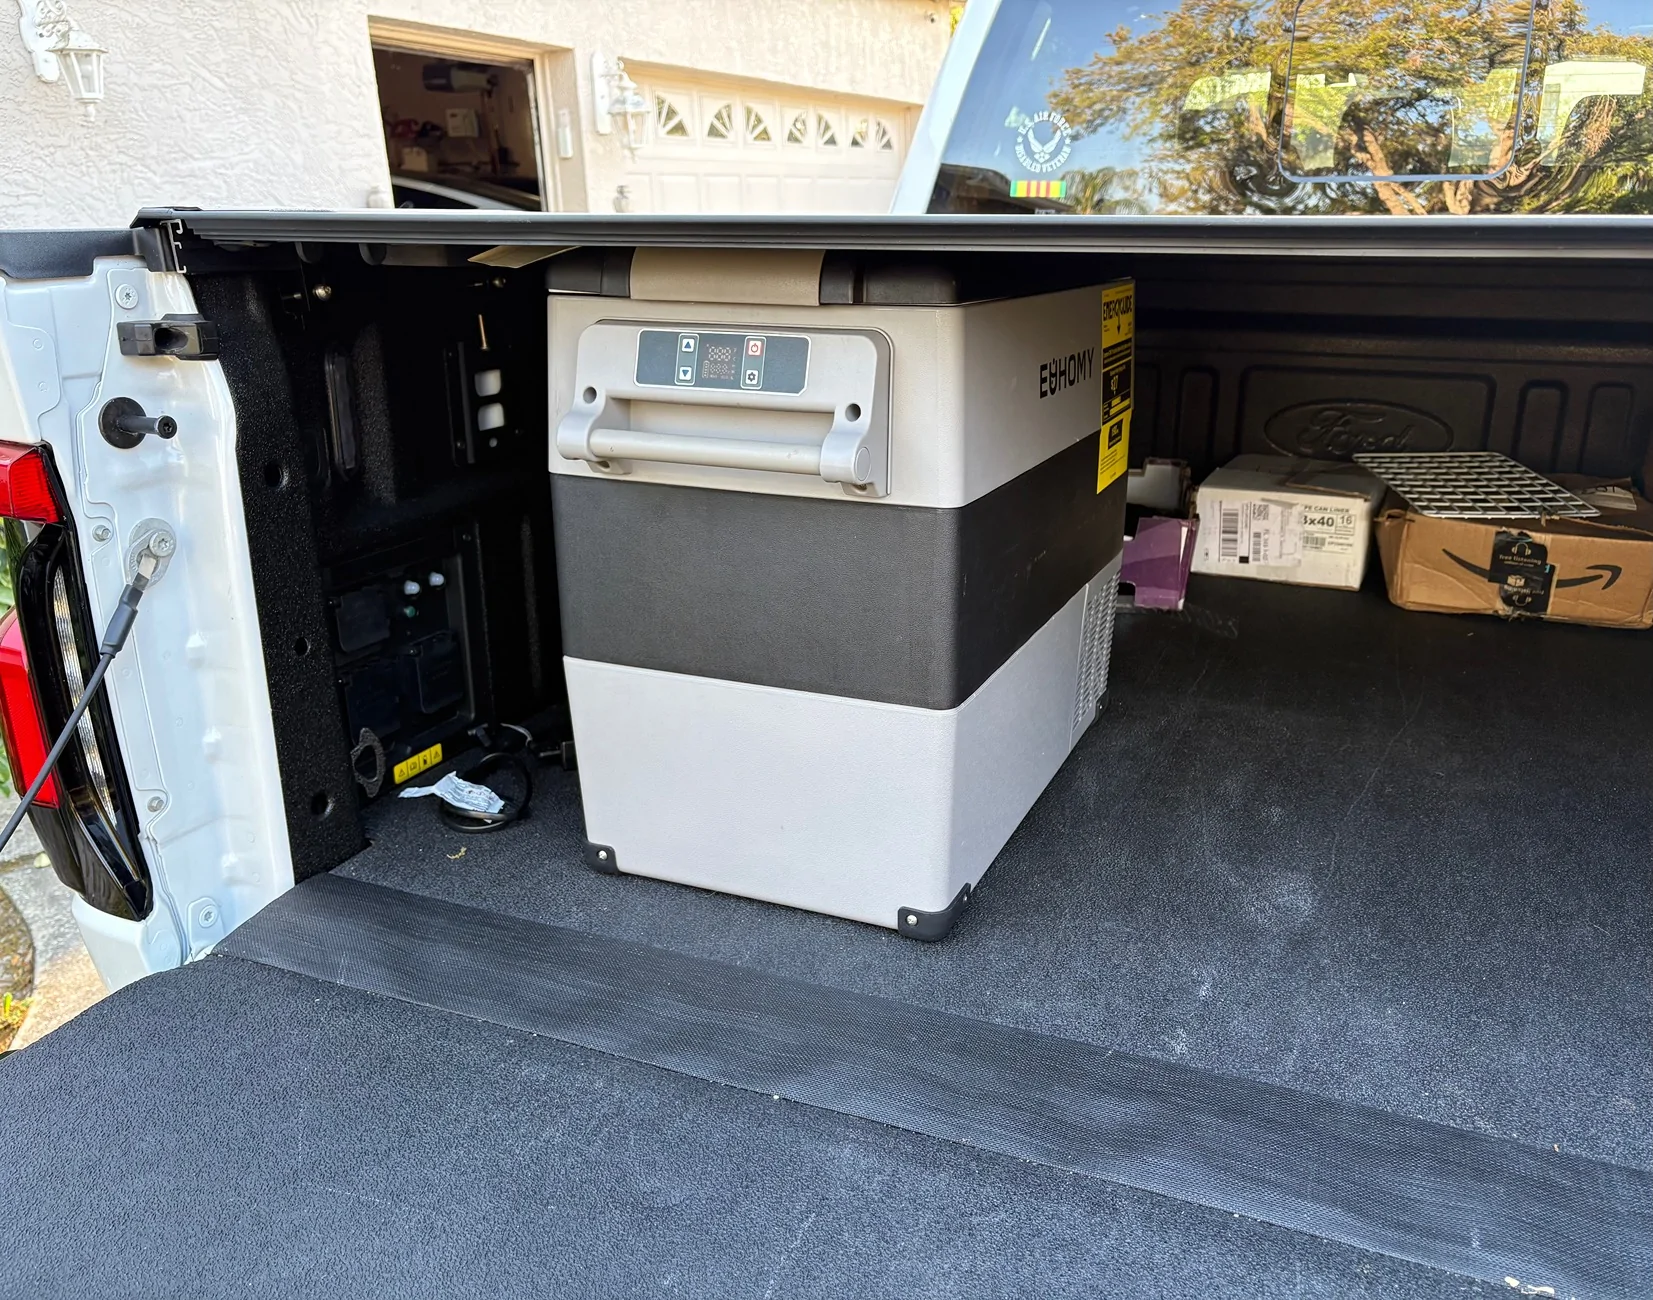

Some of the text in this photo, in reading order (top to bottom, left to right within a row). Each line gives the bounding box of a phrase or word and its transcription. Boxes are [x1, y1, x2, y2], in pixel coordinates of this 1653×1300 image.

[1034, 111, 1049, 123] AIR
[1049, 111, 1072, 137] FORCE
[1015, 143, 1072, 173] DISABLED VETERAN
[1340, 515, 1353, 525] 16
